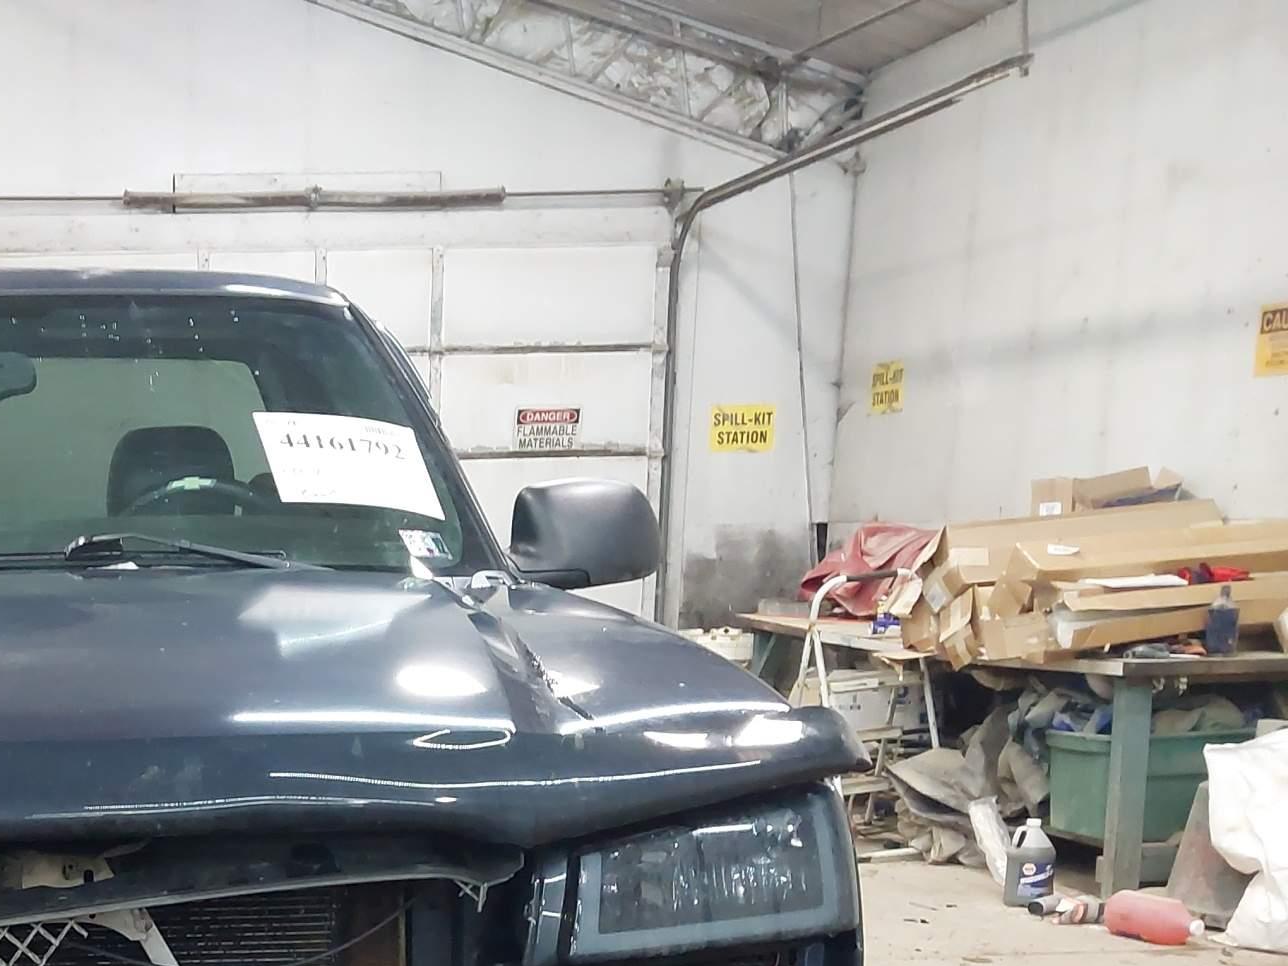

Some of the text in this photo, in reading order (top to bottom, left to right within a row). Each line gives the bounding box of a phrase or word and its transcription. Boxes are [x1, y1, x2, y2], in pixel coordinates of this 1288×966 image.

[526, 411, 570, 422] DANGER
[713, 412, 773, 426] SPILL-KIT
[517, 425, 577, 436] FLAMMABLE
[519, 437, 573, 448] MATERIALS
[717, 430, 768, 445] STATION
[280, 433, 406, 460] 44161792
